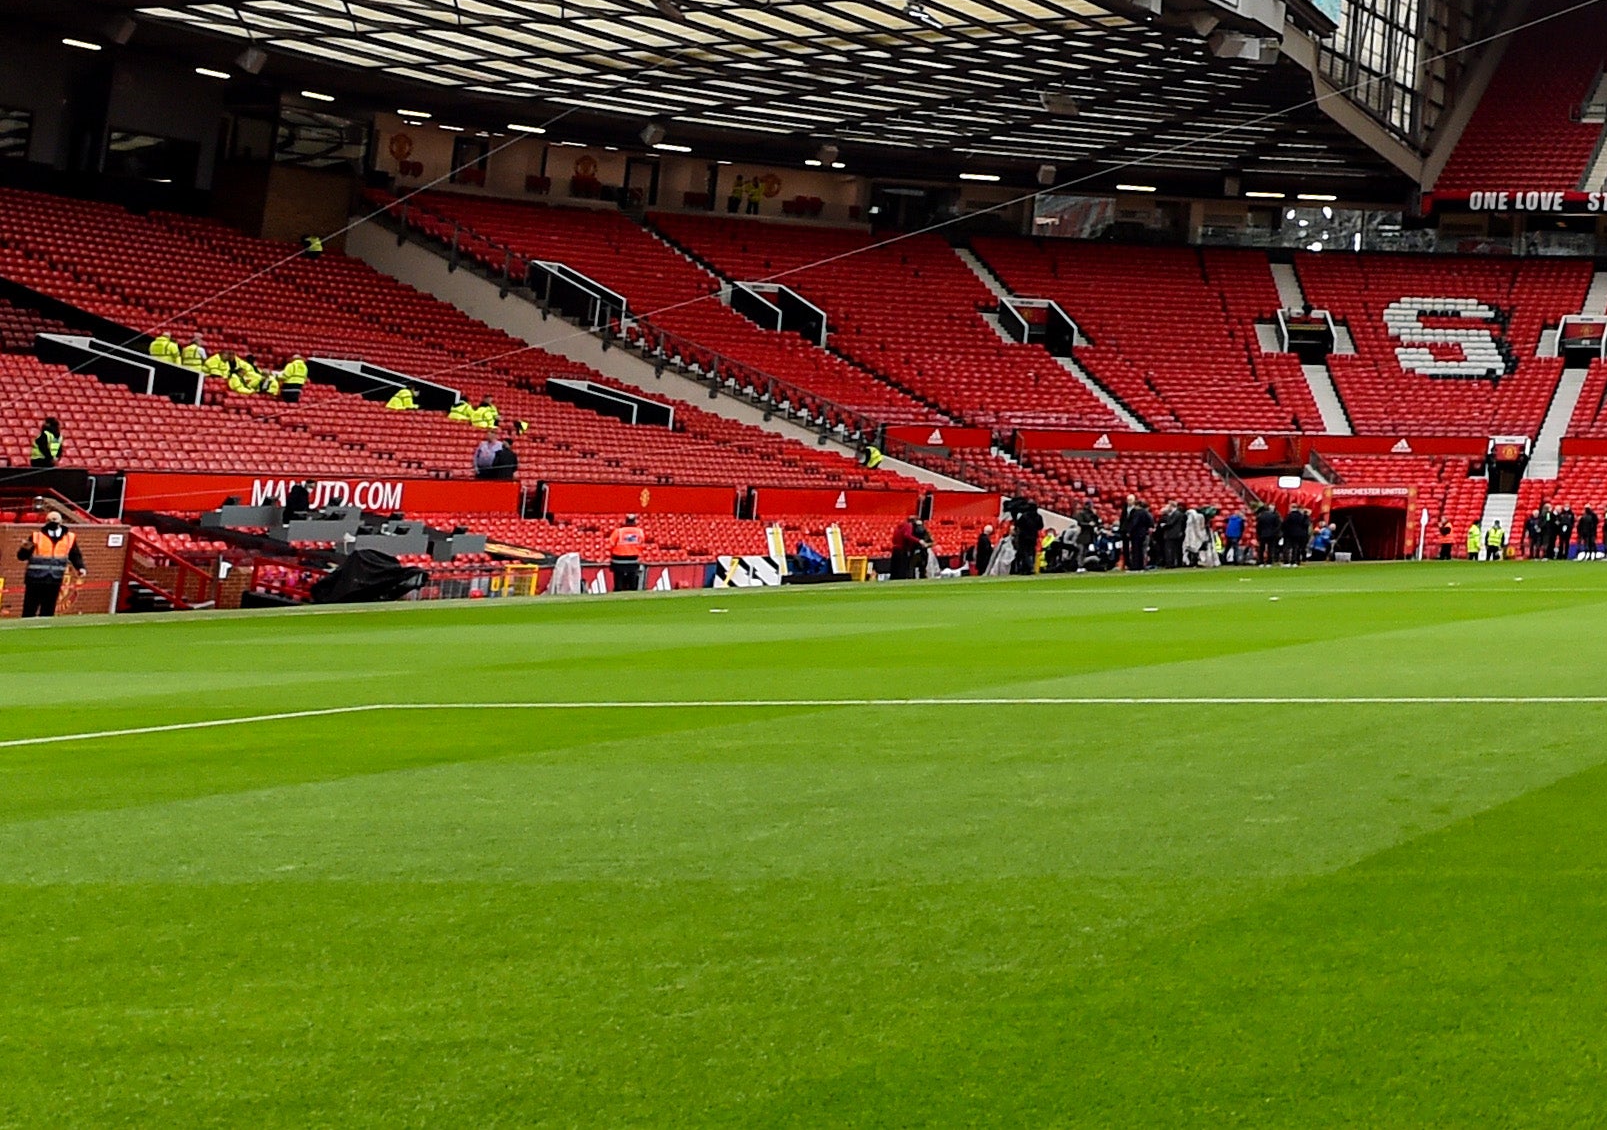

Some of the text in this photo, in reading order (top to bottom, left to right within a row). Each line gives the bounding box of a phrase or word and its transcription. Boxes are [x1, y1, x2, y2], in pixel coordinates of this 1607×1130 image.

[1469, 191, 1508, 211] ONE
[1514, 192, 1564, 211] LOVE
[250, 479, 404, 511] MAUTD.COM
